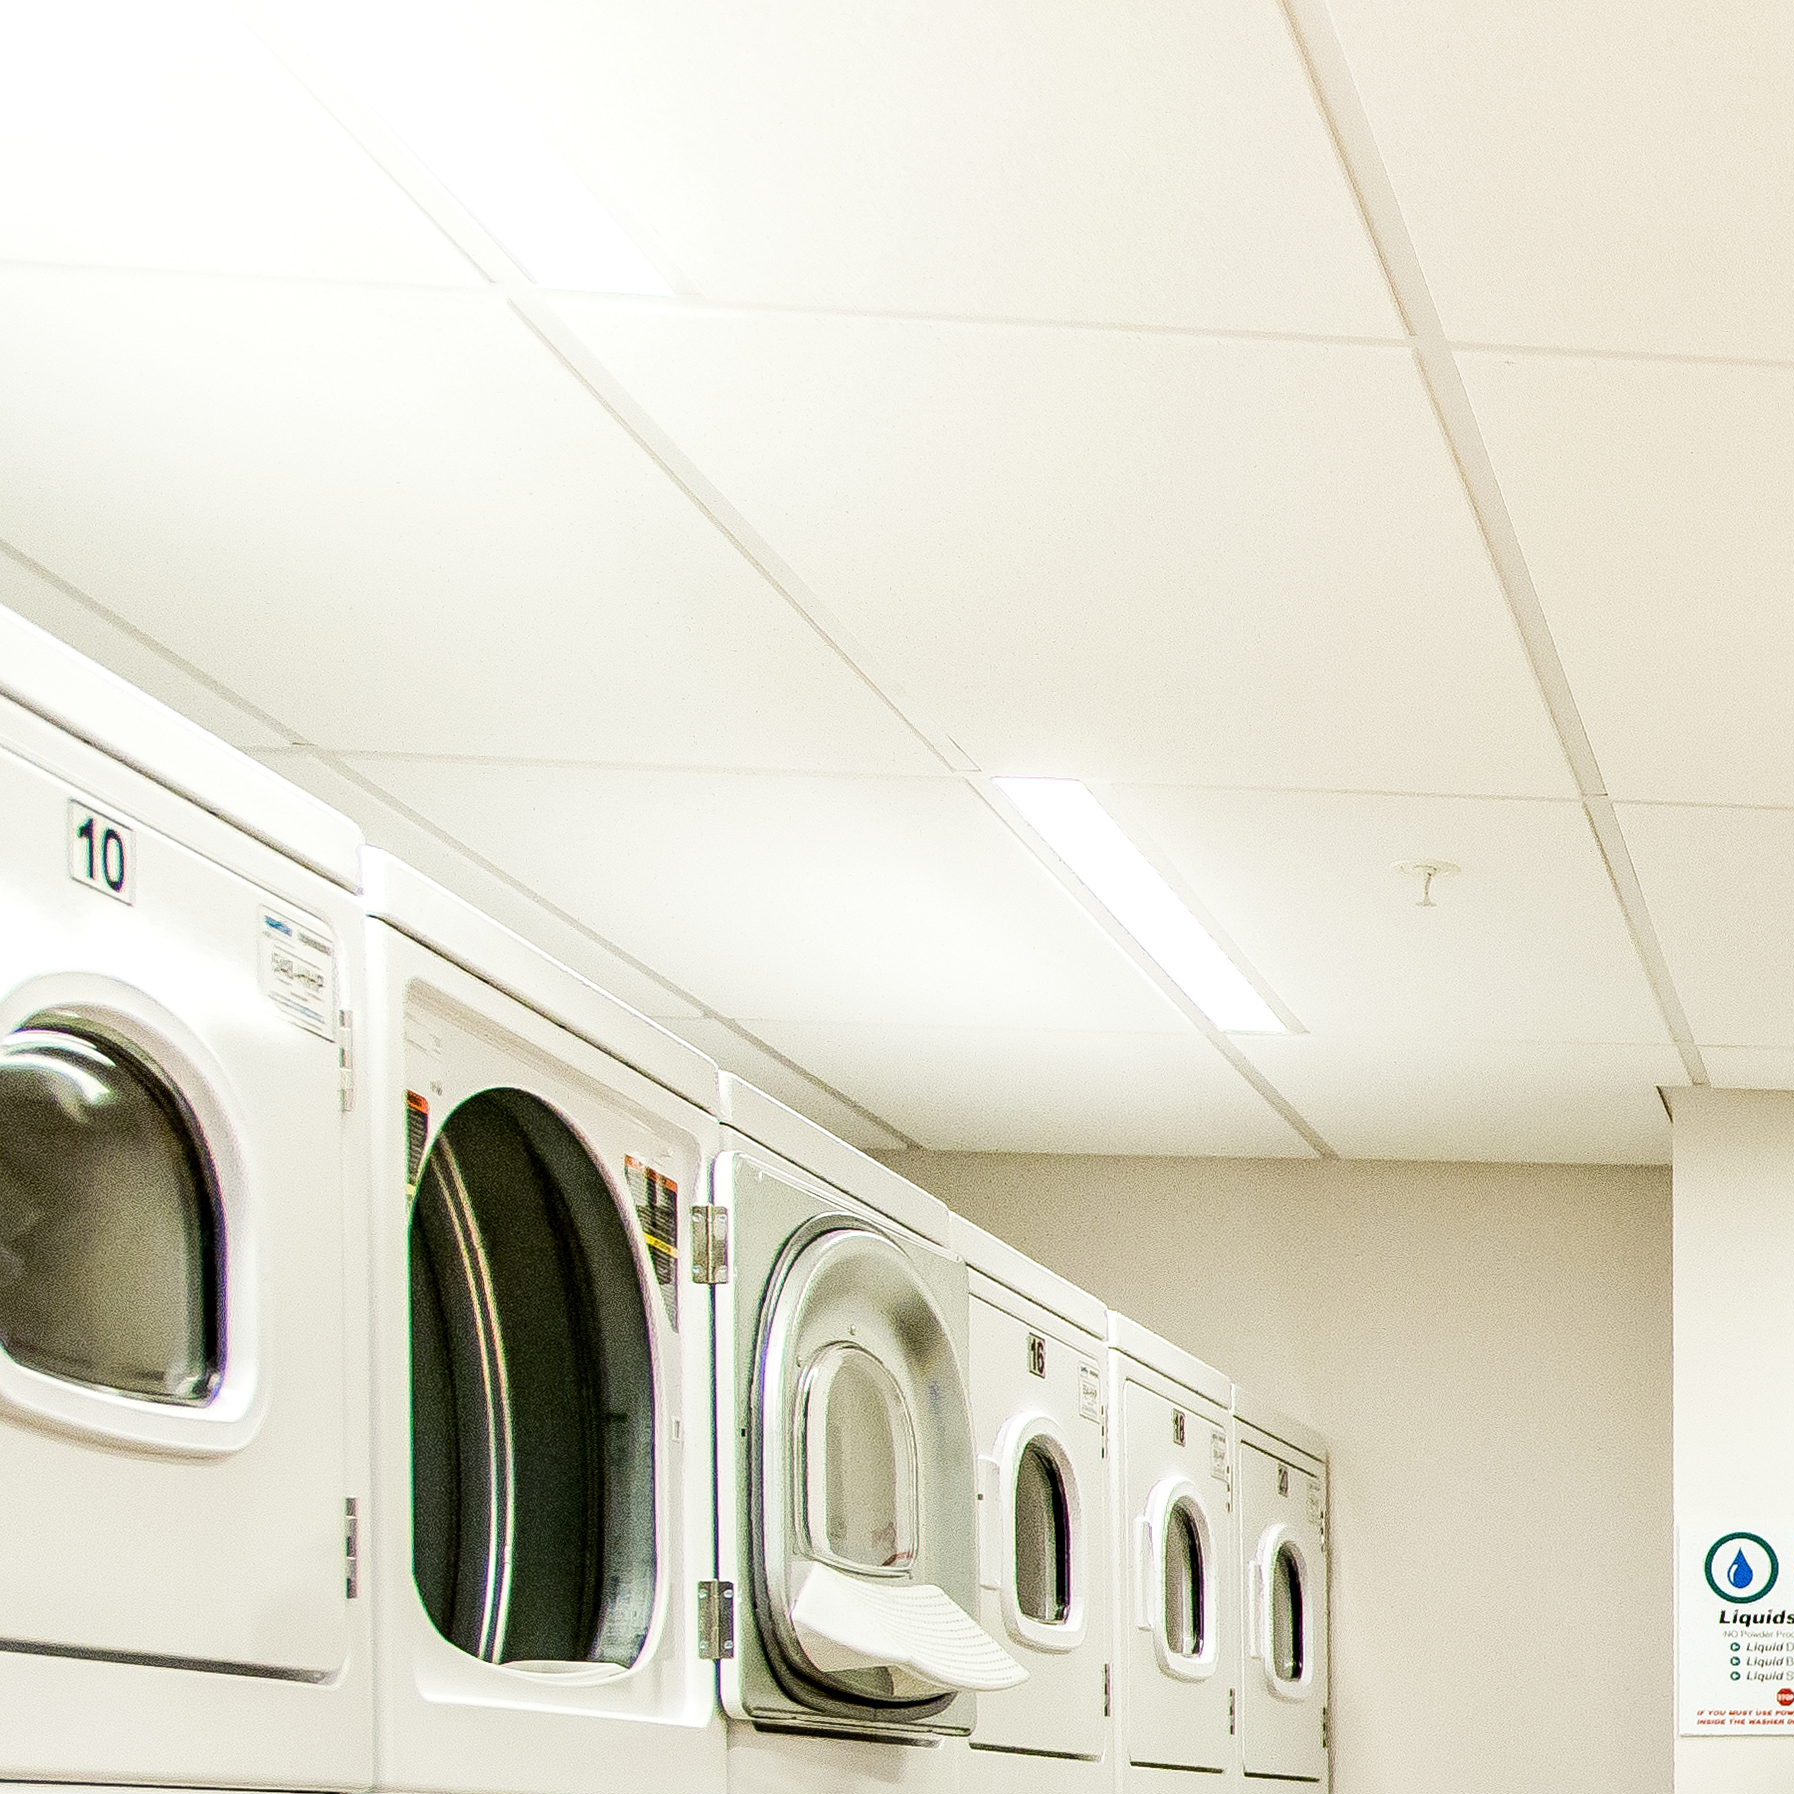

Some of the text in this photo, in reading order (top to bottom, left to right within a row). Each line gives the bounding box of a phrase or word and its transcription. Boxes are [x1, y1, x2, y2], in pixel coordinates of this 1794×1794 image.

[78, 817, 126, 892] 10
[1031, 1338, 1045, 1375] 16
[1746, 1642, 1784, 1654] Liquid
[1746, 1656, 1784, 1668] Liquid
[1746, 1671, 1784, 1682] Liquid
[1777, 1693, 1794, 1701] STOP
